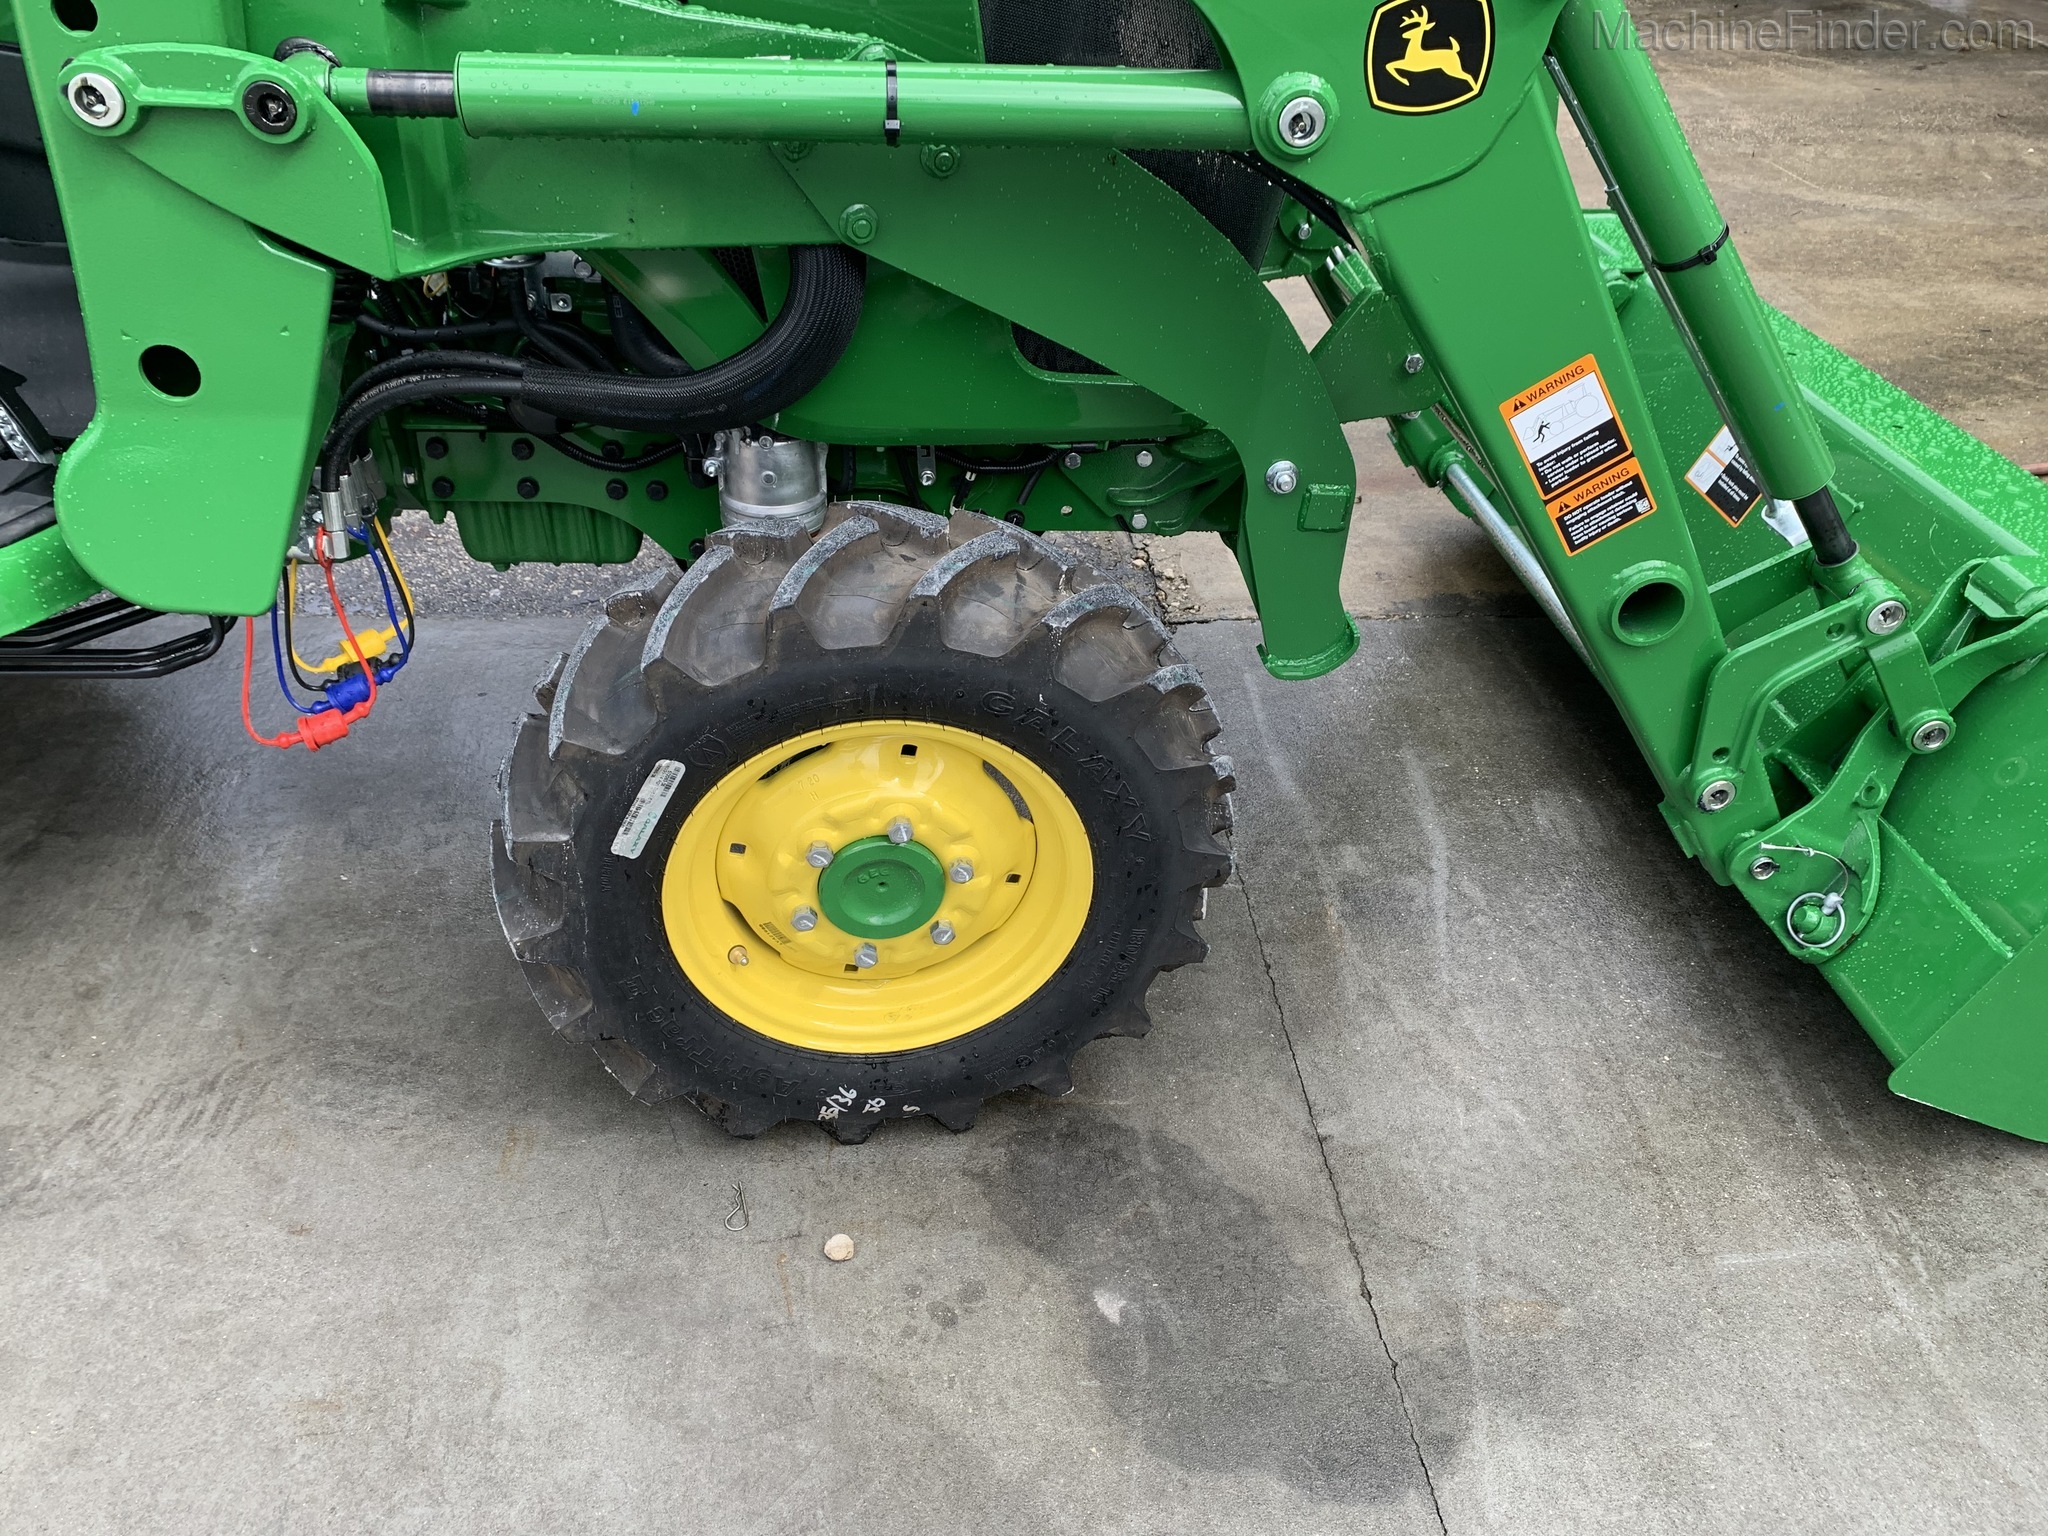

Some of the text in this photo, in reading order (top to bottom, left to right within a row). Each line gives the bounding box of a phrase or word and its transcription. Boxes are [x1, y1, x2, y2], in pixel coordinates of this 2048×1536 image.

[1526, 365, 1584, 402] WARNING
[1574, 468, 1630, 502] WARNING
[982, 689, 1152, 843] GALAXY
